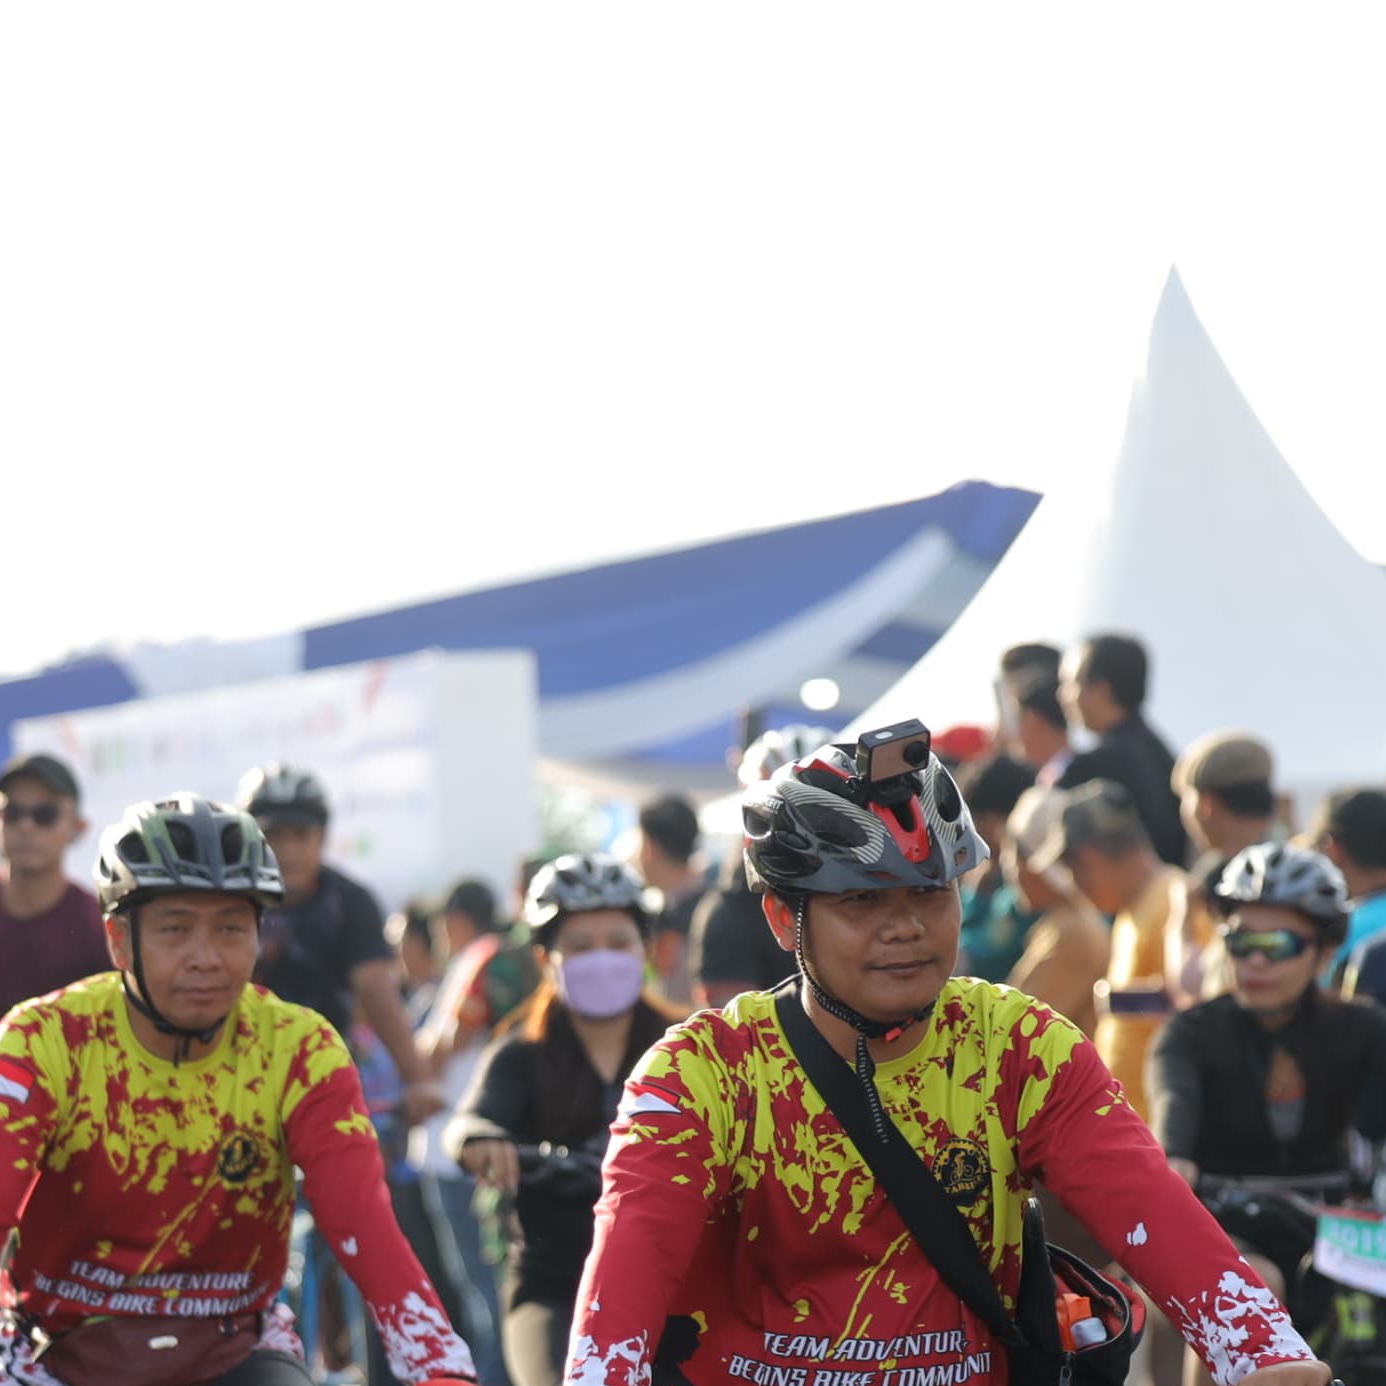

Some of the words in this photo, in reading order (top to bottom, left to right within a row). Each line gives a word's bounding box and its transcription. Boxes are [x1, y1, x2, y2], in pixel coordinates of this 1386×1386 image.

[69, 1260, 126, 1289] TEAM
[108, 1292, 159, 1316] BIKE
[764, 1331, 830, 1360] TEAM
[834, 1329, 968, 1361] ADVENTUR
